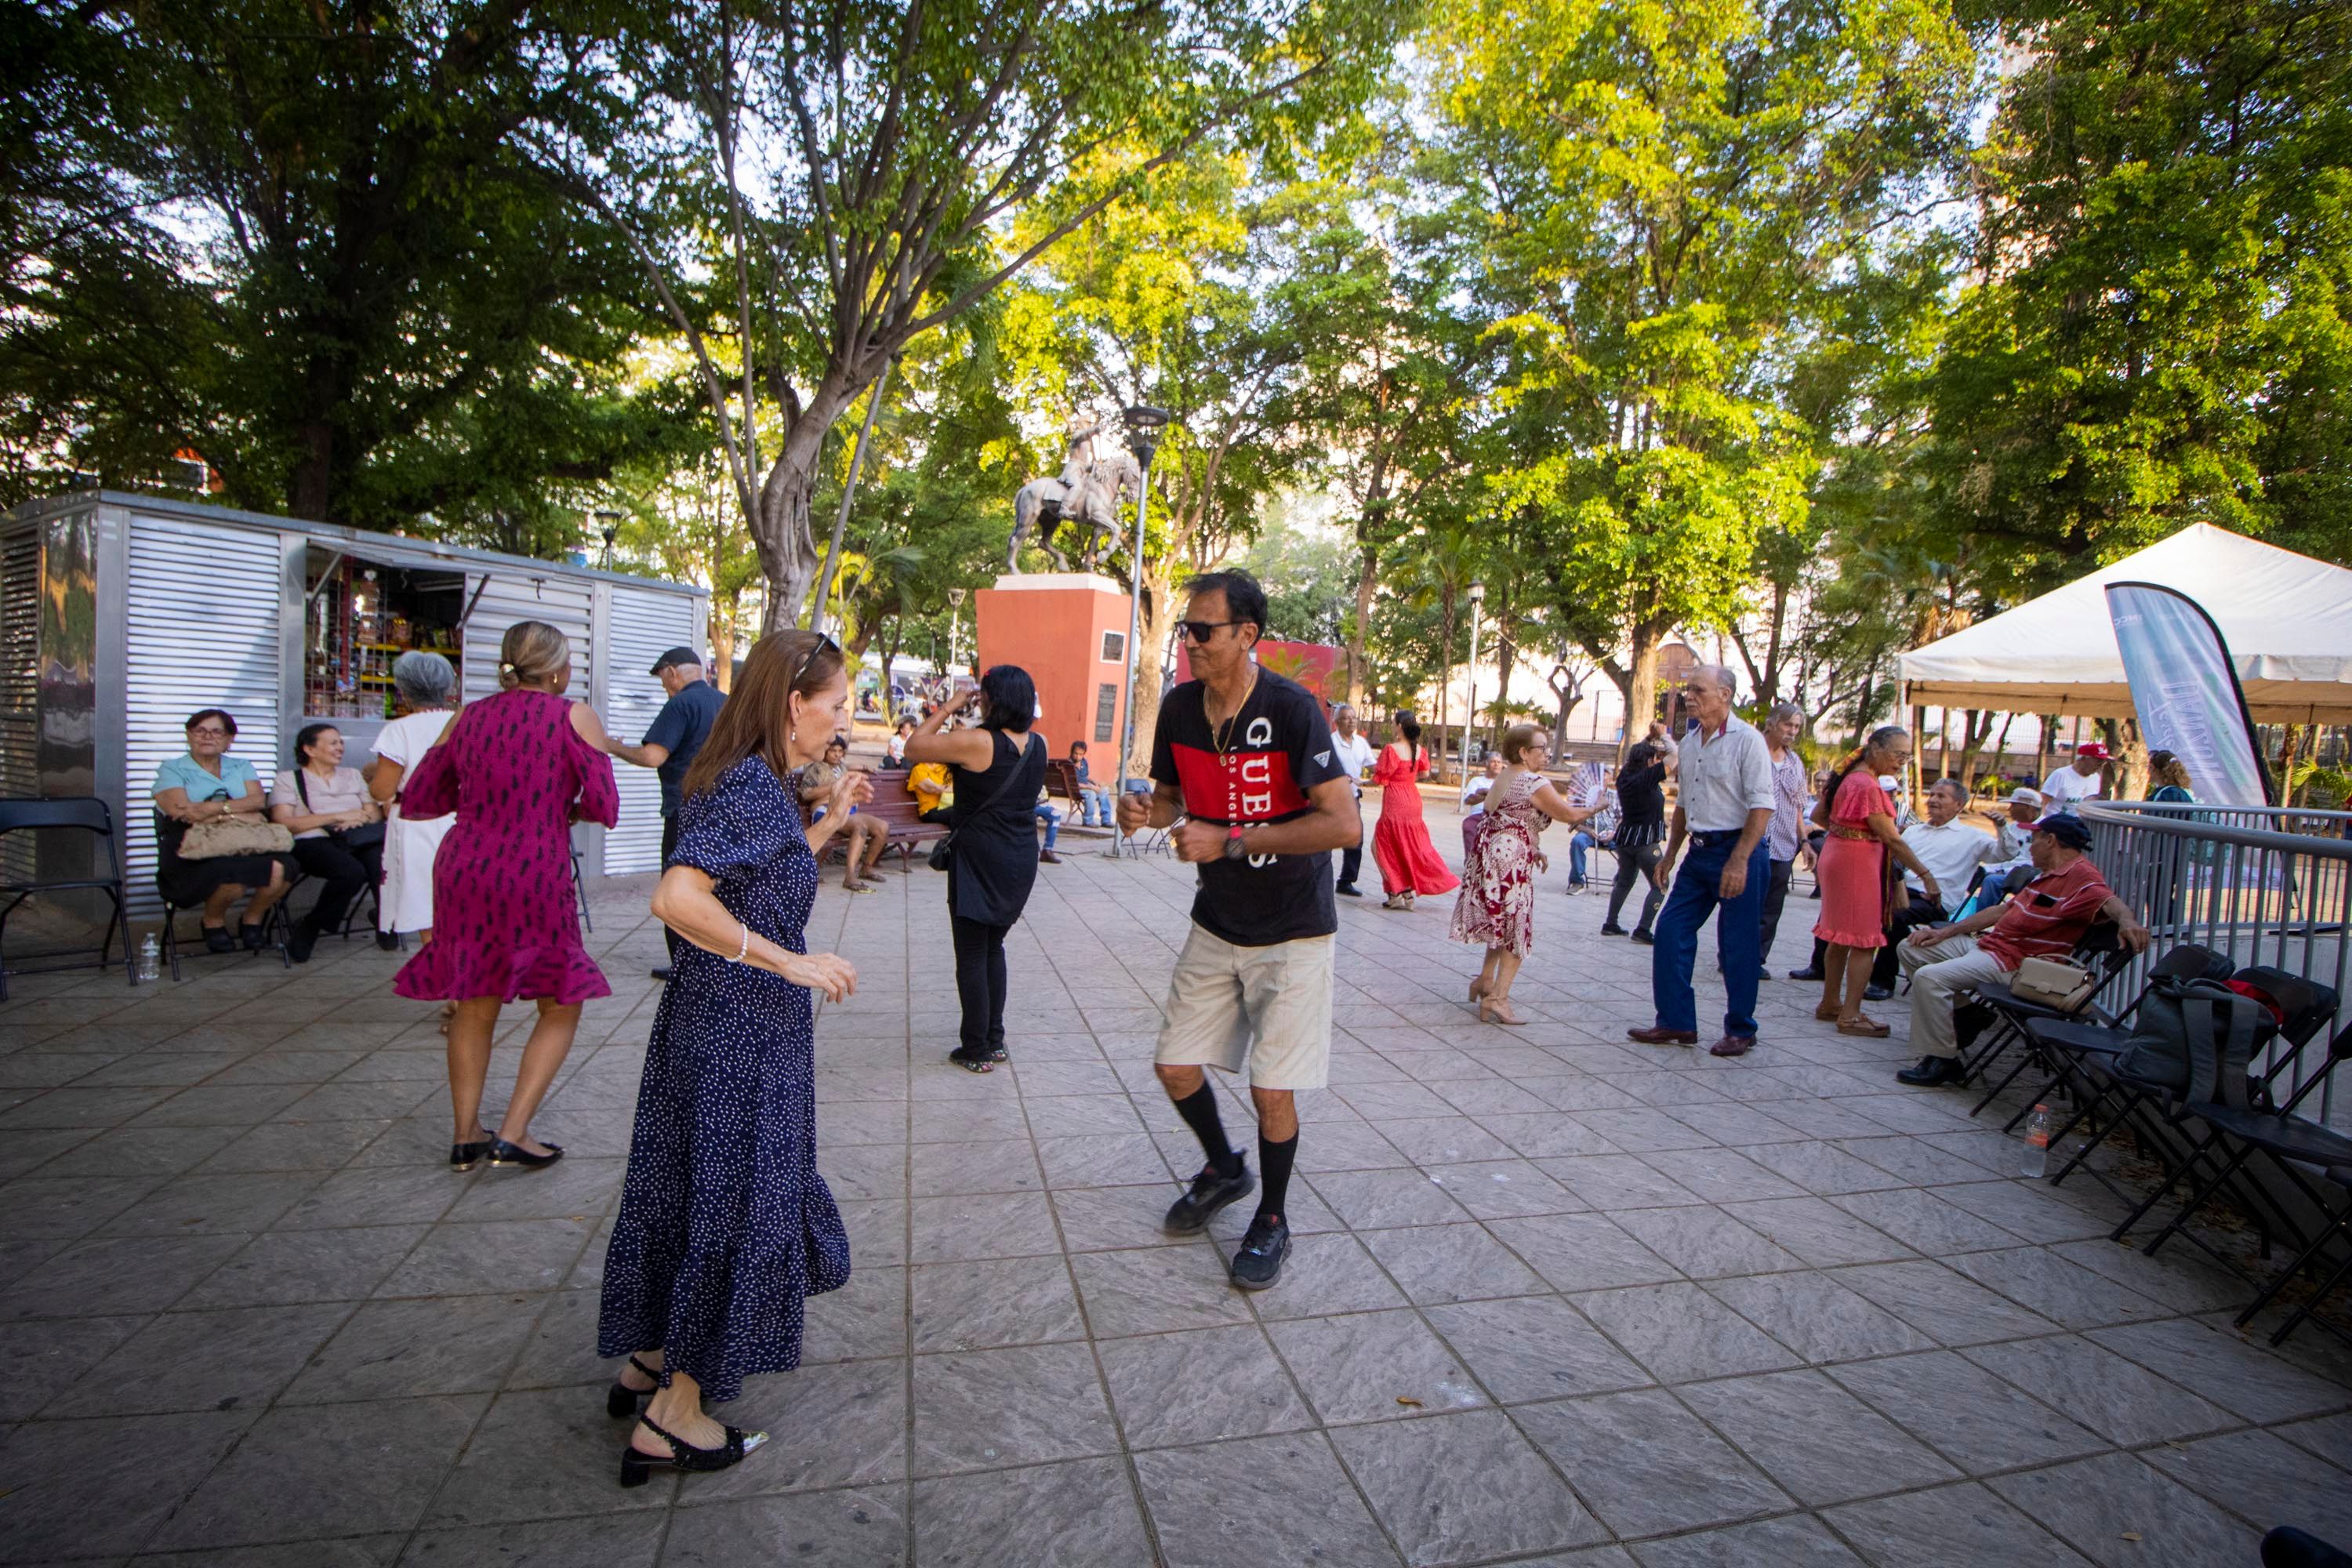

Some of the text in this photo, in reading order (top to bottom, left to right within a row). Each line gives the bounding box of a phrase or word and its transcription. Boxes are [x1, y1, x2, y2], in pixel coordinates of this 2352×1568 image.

[1228, 746, 1238, 827] LOS ANGEL
[1242, 717, 1278, 868] GUES
